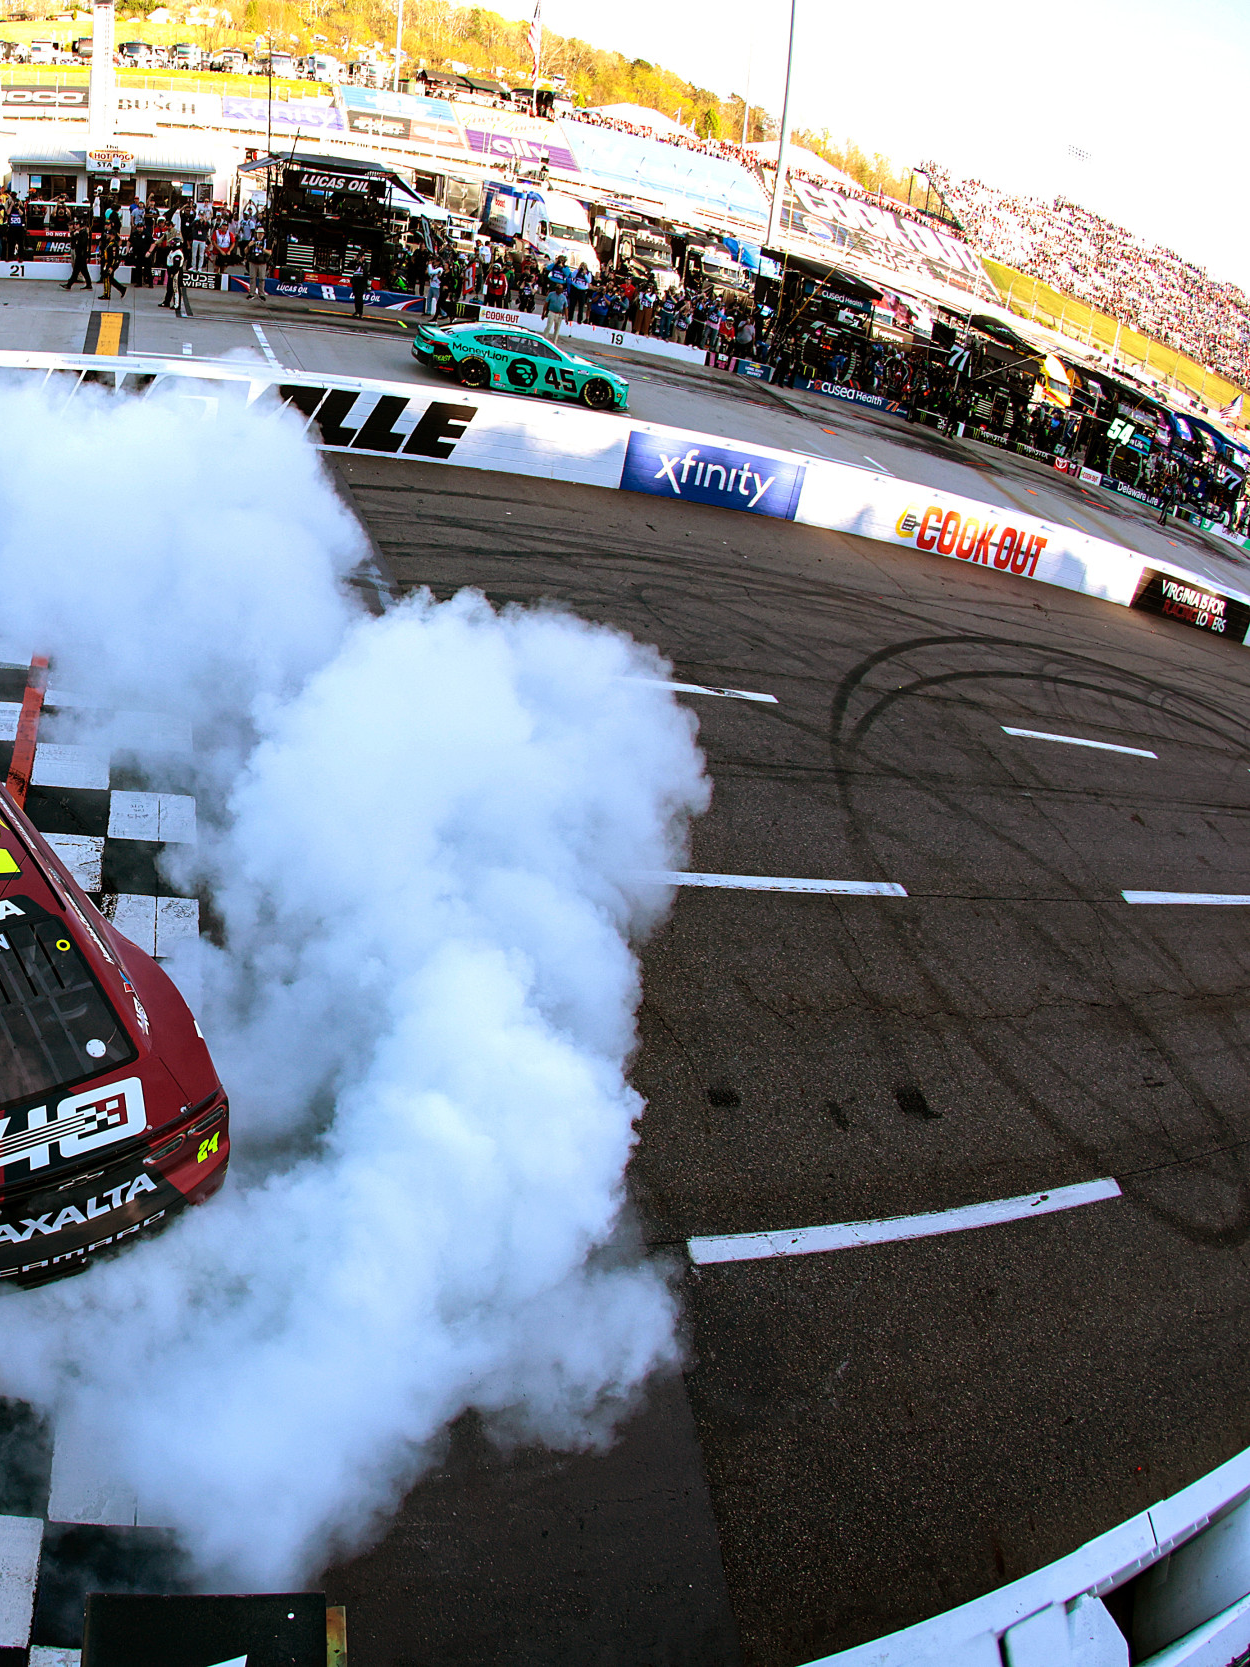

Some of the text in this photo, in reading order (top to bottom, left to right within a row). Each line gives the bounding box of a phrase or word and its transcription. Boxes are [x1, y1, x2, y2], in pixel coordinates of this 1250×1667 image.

[492, 138, 550, 158] ally
[300, 174, 370, 193] LUCAS OIL
[791, 178, 916, 250] COOK
[50, 242, 70, 252] NAS
[10, 265, 25, 277] 21
[182, 273, 216, 283] DUDE
[182, 281, 215, 290] WIPES
[276, 282, 308, 294] LUCAS OIL
[320, 285, 336, 301] 8
[370, 294, 381, 302] OIL
[485, 310, 520, 324] COOK OUT
[611, 332, 623, 345] 19
[452, 342, 509, 363] MoneyLion
[949, 344, 970, 371] 71
[544, 366, 578, 394] 45
[855, 392, 883, 407] Health
[885, 400, 901, 412] 71
[980, 429, 1008, 445] MONSTER
[1107, 418, 1135, 445] 54
[1054, 444, 1066, 455] 54
[654, 449, 776, 508] xfinity
[1222, 467, 1242, 491] 77
[1117, 481, 1159, 506] Delaware Life
[916, 505, 1048, 577] COOK OUT
[1162, 579, 1201, 608] VIRGINIA
[1207, 597, 1226, 616] FOR
[196, 1131, 220, 1164] 24
